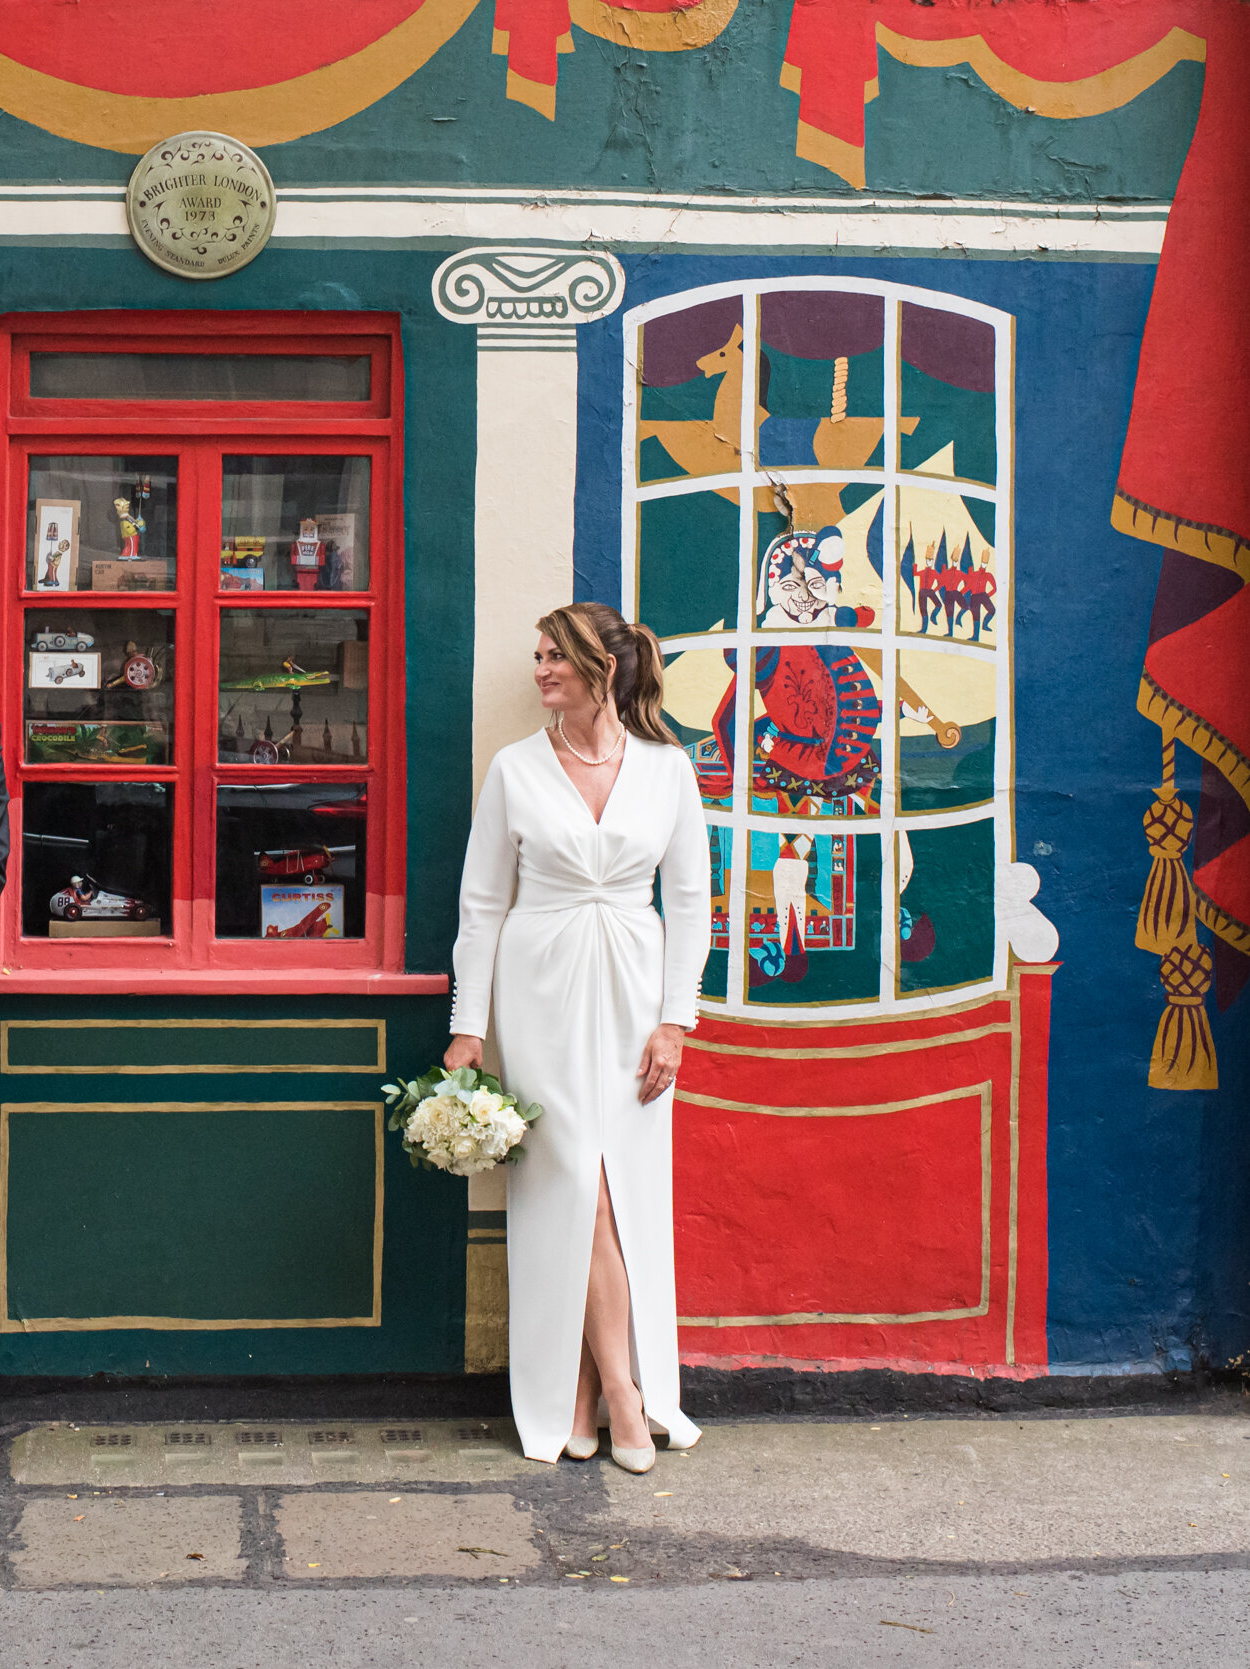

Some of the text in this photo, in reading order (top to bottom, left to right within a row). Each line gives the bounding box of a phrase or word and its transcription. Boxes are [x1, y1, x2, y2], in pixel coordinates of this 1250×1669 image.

[143, 174, 262, 202] BRIGHTER LONDON
[179, 197, 222, 208] AWARD
[185, 210, 216, 221] 1973
[141, 219, 205, 267] EVENING STANDARD
[217, 224, 260, 264] DULUX PAINTS
[31, 734, 76, 742] CROCODILE
[57, 896, 71, 907] 88
[272, 893, 335, 902] CURTISS
